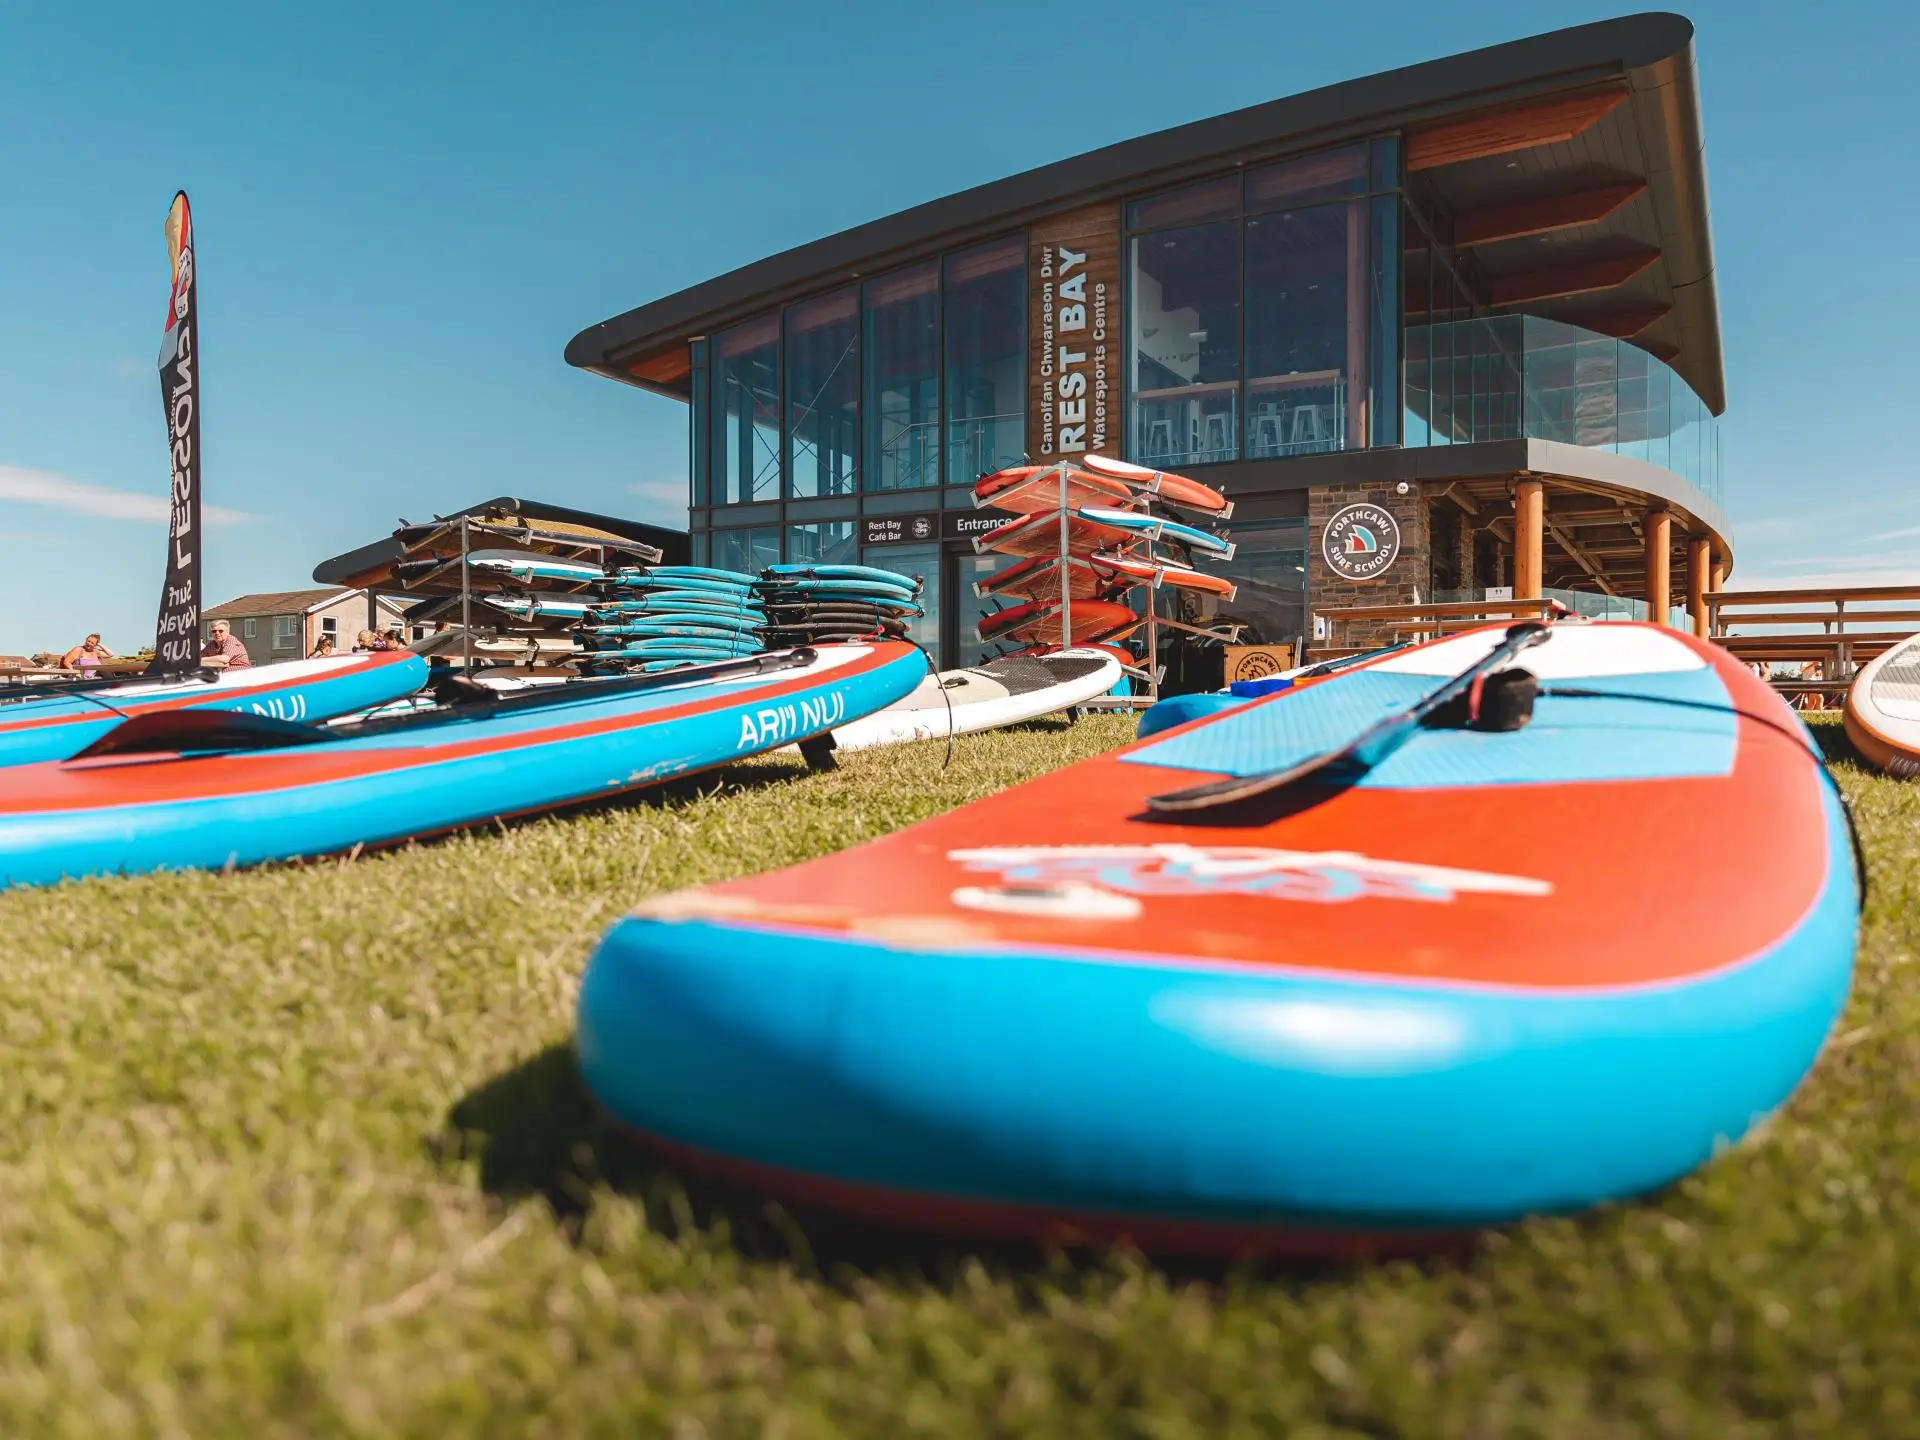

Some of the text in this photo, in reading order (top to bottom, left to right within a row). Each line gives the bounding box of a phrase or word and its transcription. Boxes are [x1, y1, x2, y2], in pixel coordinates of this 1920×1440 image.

[1041, 282, 1053, 377] Chwaraeon
[1059, 247, 1086, 453] REST BAY
[1093, 283, 1108, 450] Watersports Centre
[1041, 381, 1053, 454] Canolfan
[868, 521, 886, 531] Rest
[887, 520, 902, 531] Bay
[868, 531, 901, 542] Café Bar
[957, 517, 1012, 532] Entrance
[1331, 510, 1391, 538] PORTHCAWL
[1331, 543, 1392, 573] SURF SCHOOL
[1240, 656, 1276, 673] PORTHCAWL
[800, 691, 845, 732] NUI
